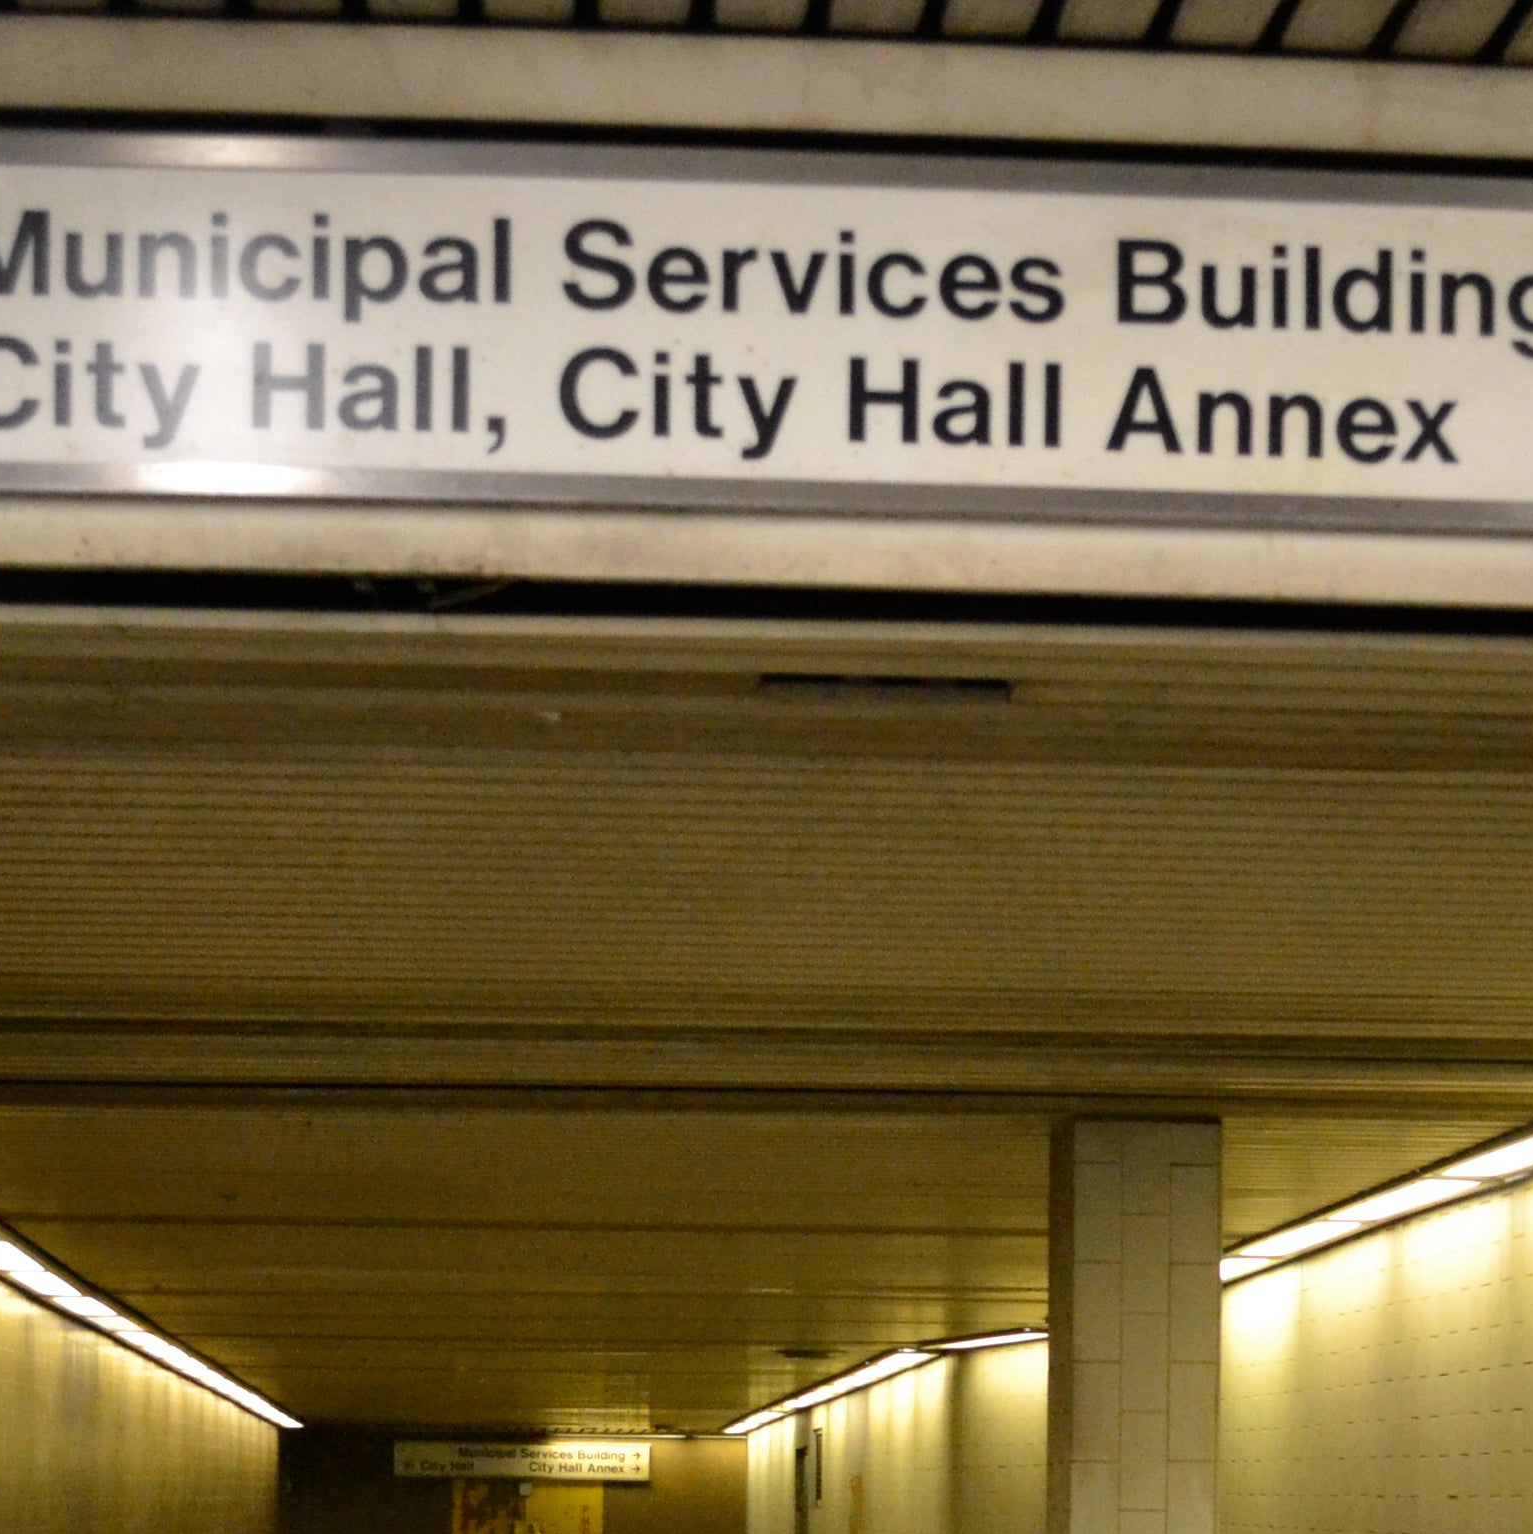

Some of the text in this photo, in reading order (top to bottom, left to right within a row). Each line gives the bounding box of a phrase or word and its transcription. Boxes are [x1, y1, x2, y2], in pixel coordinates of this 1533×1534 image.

[561, 218, 1066, 325] Services
[251, 341, 507, 454] Hall,
[557, 345, 799, 461] City
[847, 356, 1063, 449] Hall
[1104, 365, 1461, 465] Annex
[458, 1446, 626, 1462] Municipal Services Building
[419, 1460, 475, 1473] City Hall
[528, 1461, 625, 1474] City Hall Annex
